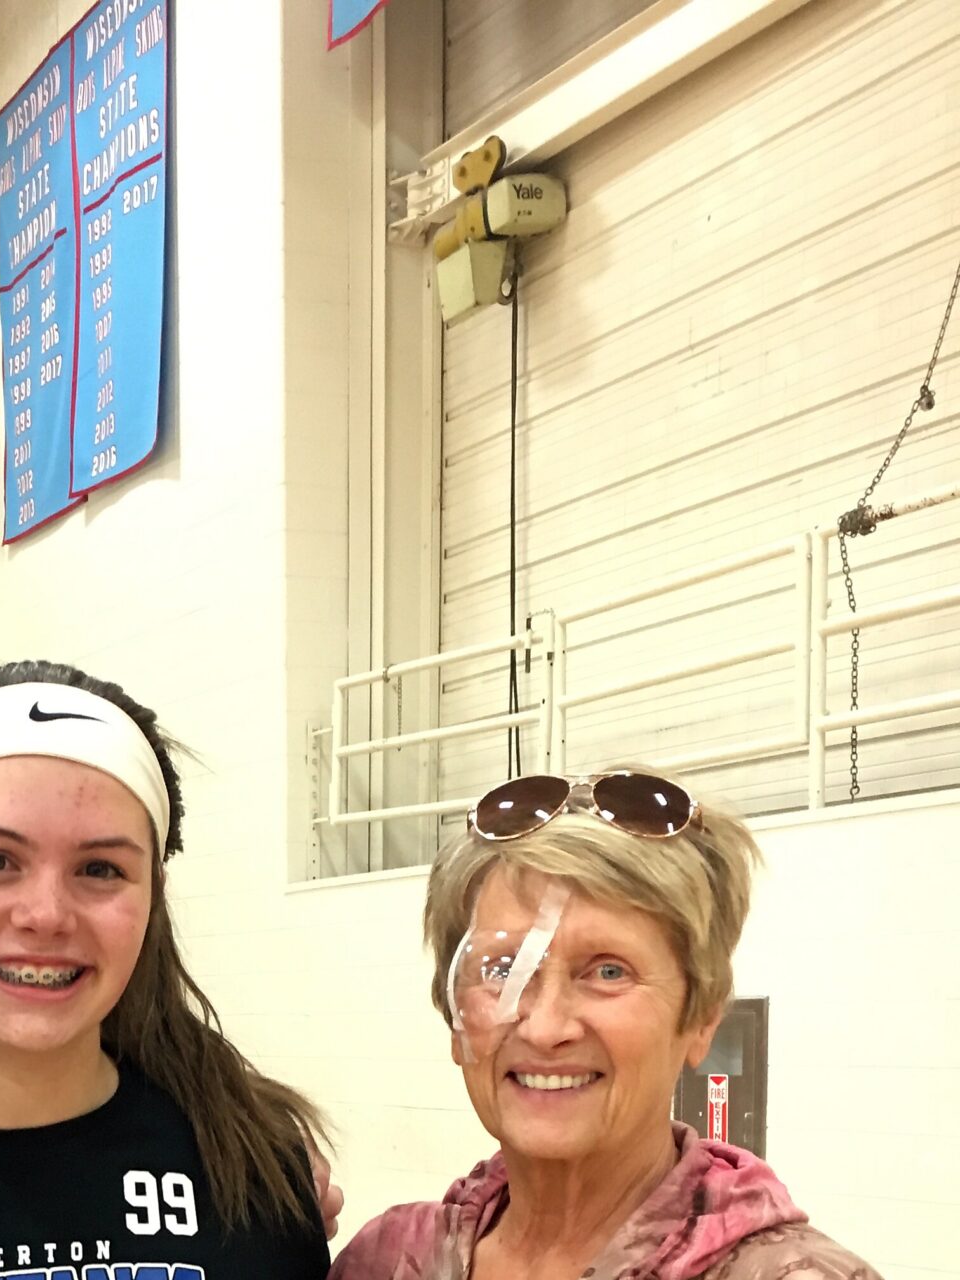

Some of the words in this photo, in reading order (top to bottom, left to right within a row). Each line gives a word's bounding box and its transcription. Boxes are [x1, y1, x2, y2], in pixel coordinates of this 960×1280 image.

[6, 64, 61, 148] WISCONSIN
[18, 163, 50, 220] STATE
[123, 174, 158, 215] 2017
[512, 183, 544, 200] Yale
[87, 208, 112, 245] 1992
[10, 315, 31, 347] 1992
[41, 323, 60, 354] 2016
[40, 355, 62, 386] 2017
[10, 377, 31, 405] 998
[94, 412, 115, 445] 2013
[14, 440, 31, 468] 2011
[91, 445, 117, 477] 2016
[710, 1087, 726, 1100] FIRE
[123, 1170, 199, 1236] 99
